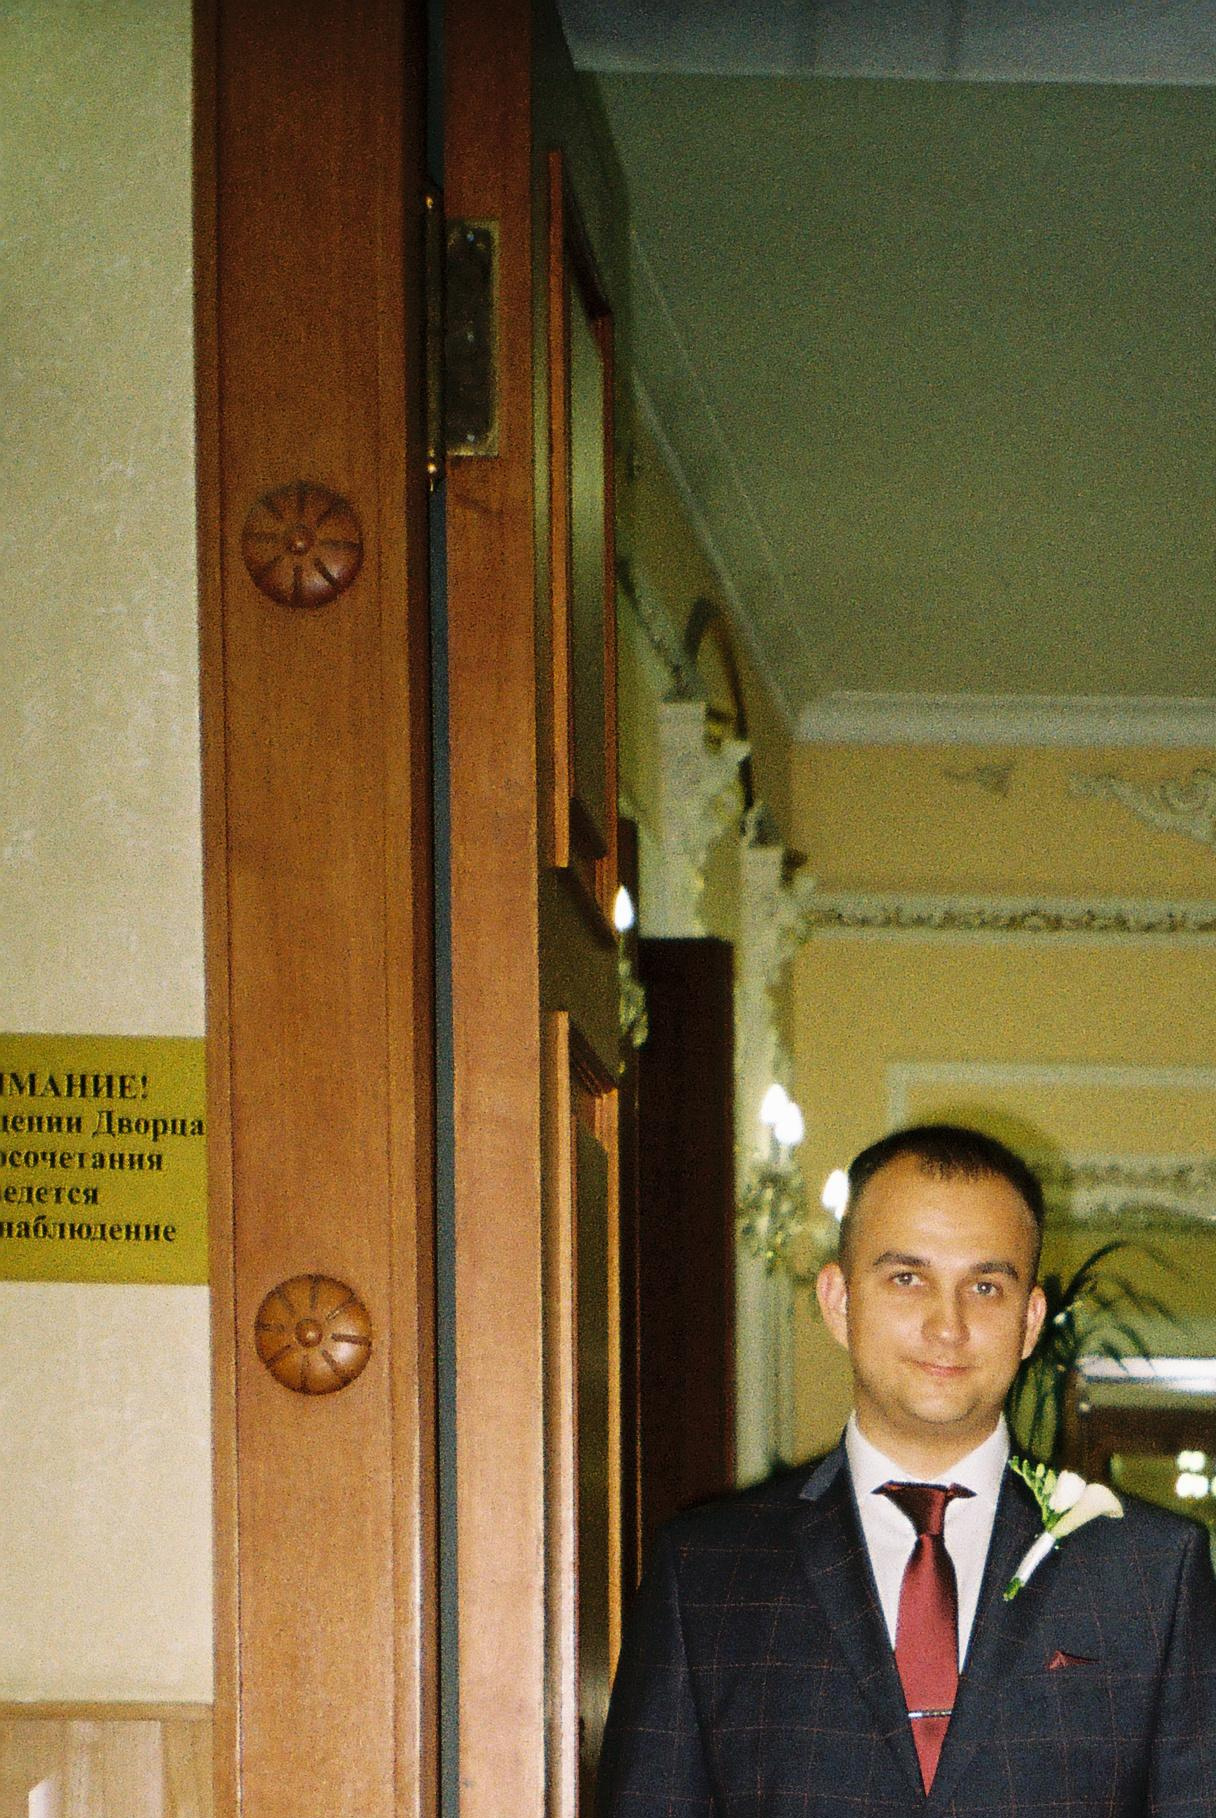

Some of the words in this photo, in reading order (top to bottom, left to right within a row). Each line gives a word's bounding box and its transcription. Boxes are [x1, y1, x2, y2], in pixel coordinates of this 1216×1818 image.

[0, 1071, 149, 1100] МАНИЕ!
[91, 1109, 205, 1143] Дворца
[0, 1184, 99, 1206] едется
